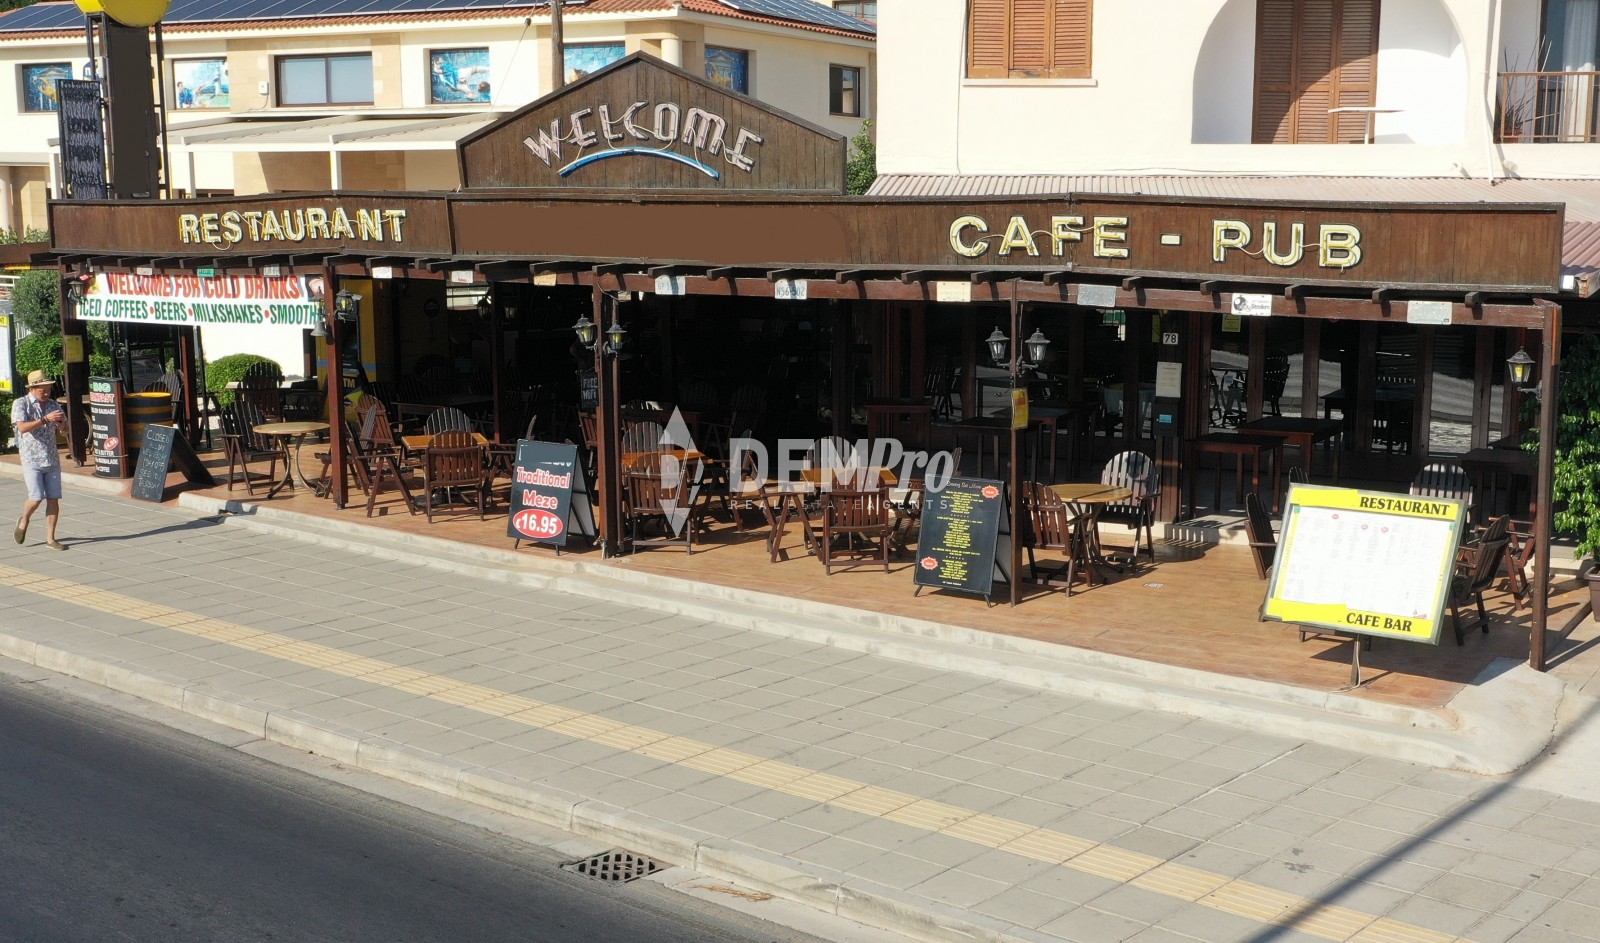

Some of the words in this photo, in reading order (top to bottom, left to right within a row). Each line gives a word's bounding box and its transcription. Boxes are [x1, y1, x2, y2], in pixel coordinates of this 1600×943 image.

[523, 100, 764, 174] WELCOME
[179, 206, 408, 244] RESTAURANT
[949, 214, 1130, 259] CAFE
[1211, 218, 1364, 269] PUB
[107, 271, 171, 297] WELCOME
[174, 273, 201, 298] FOR
[205, 274, 243, 300] COLD
[245, 274, 301, 300] DRINKS
[104, 299, 149, 319] COFFEES
[154, 301, 188, 321] BEERS
[192, 302, 263, 324] MILKSHAKES
[1164, 333, 1177, 344] 78
[92, 382, 111, 393] BIG
[146, 429, 170, 444] CLOSED
[517, 466, 571, 489] Traditional
[522, 489, 558, 509] Meze
[1359, 496, 1451, 516] RESTAURANT
[515, 512, 558, 535] €16.95
[1346, 612, 1381, 628] CAFE
[1383, 615, 1413, 632] BAR
